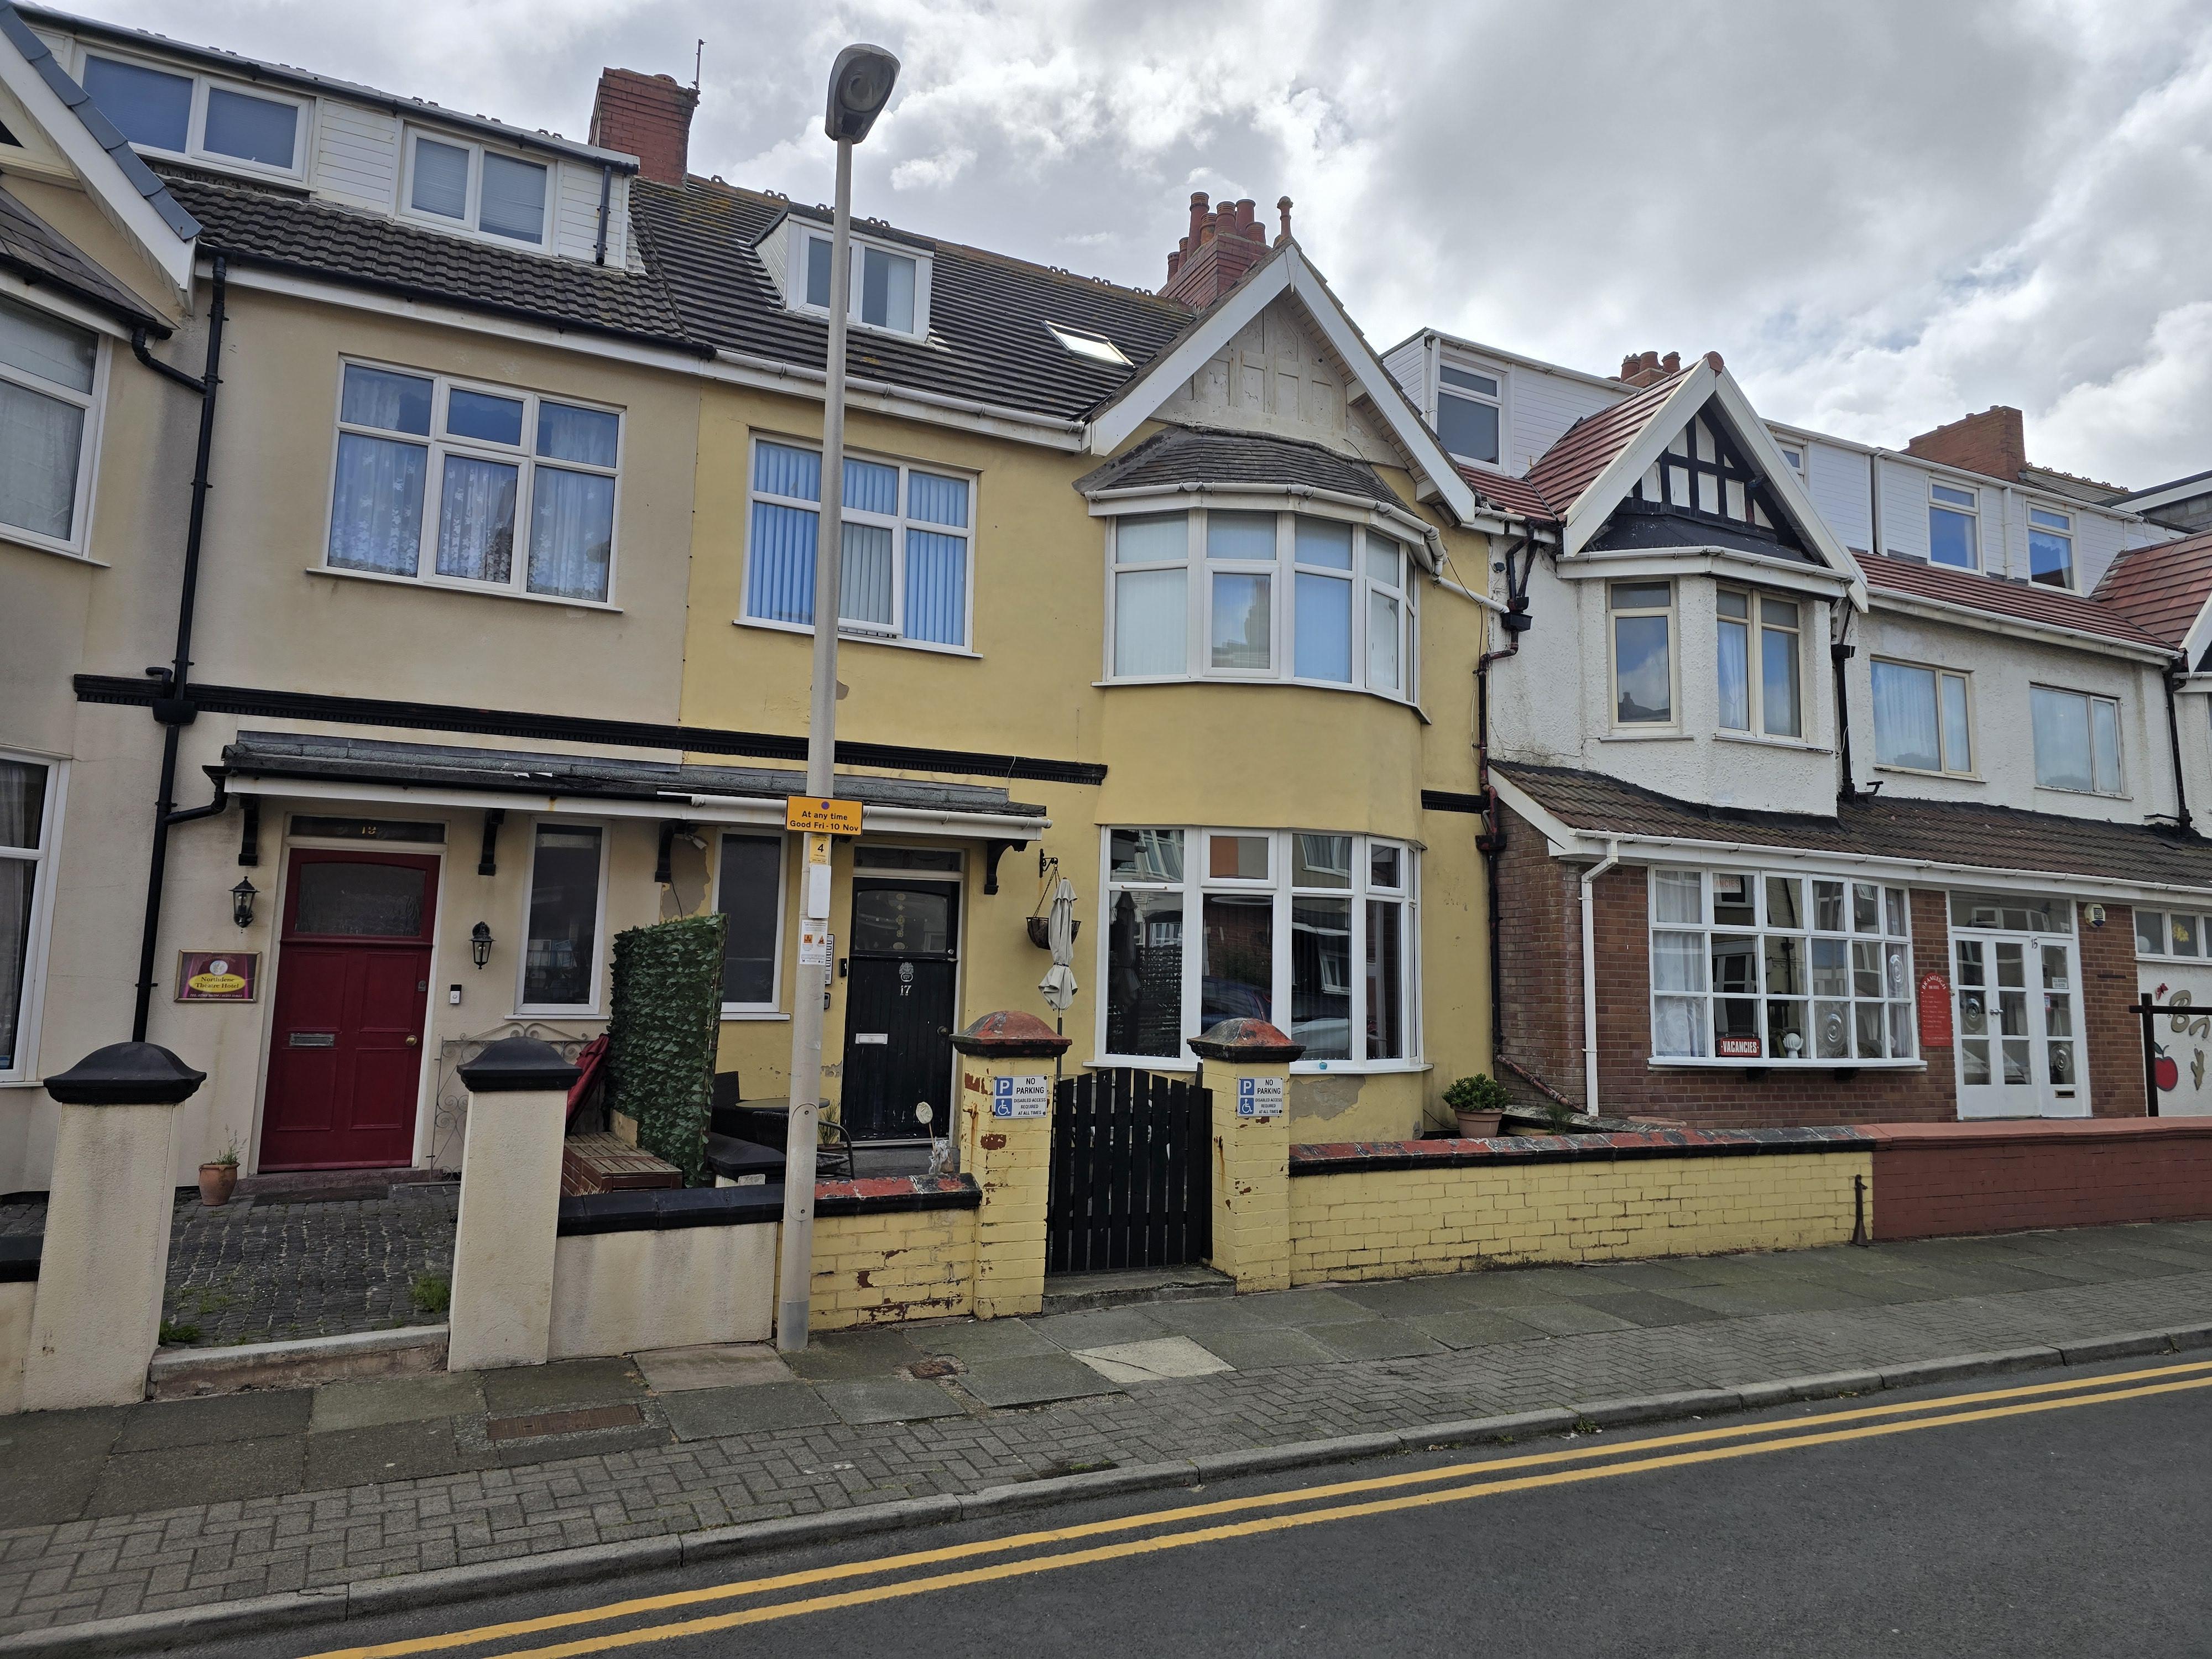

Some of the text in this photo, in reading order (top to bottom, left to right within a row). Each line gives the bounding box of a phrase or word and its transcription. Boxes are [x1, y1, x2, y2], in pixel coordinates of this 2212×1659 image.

[817, 843, 824, 852] 4
[1715, 879, 1740, 888] ANCIES
[2031, 938, 2038, 949] 15
[900, 985, 912, 995] 17
[1723, 1041, 1757, 1053] VACANCIES
[999, 1080, 1010, 1094] P
[1243, 1081, 1252, 1094] P
